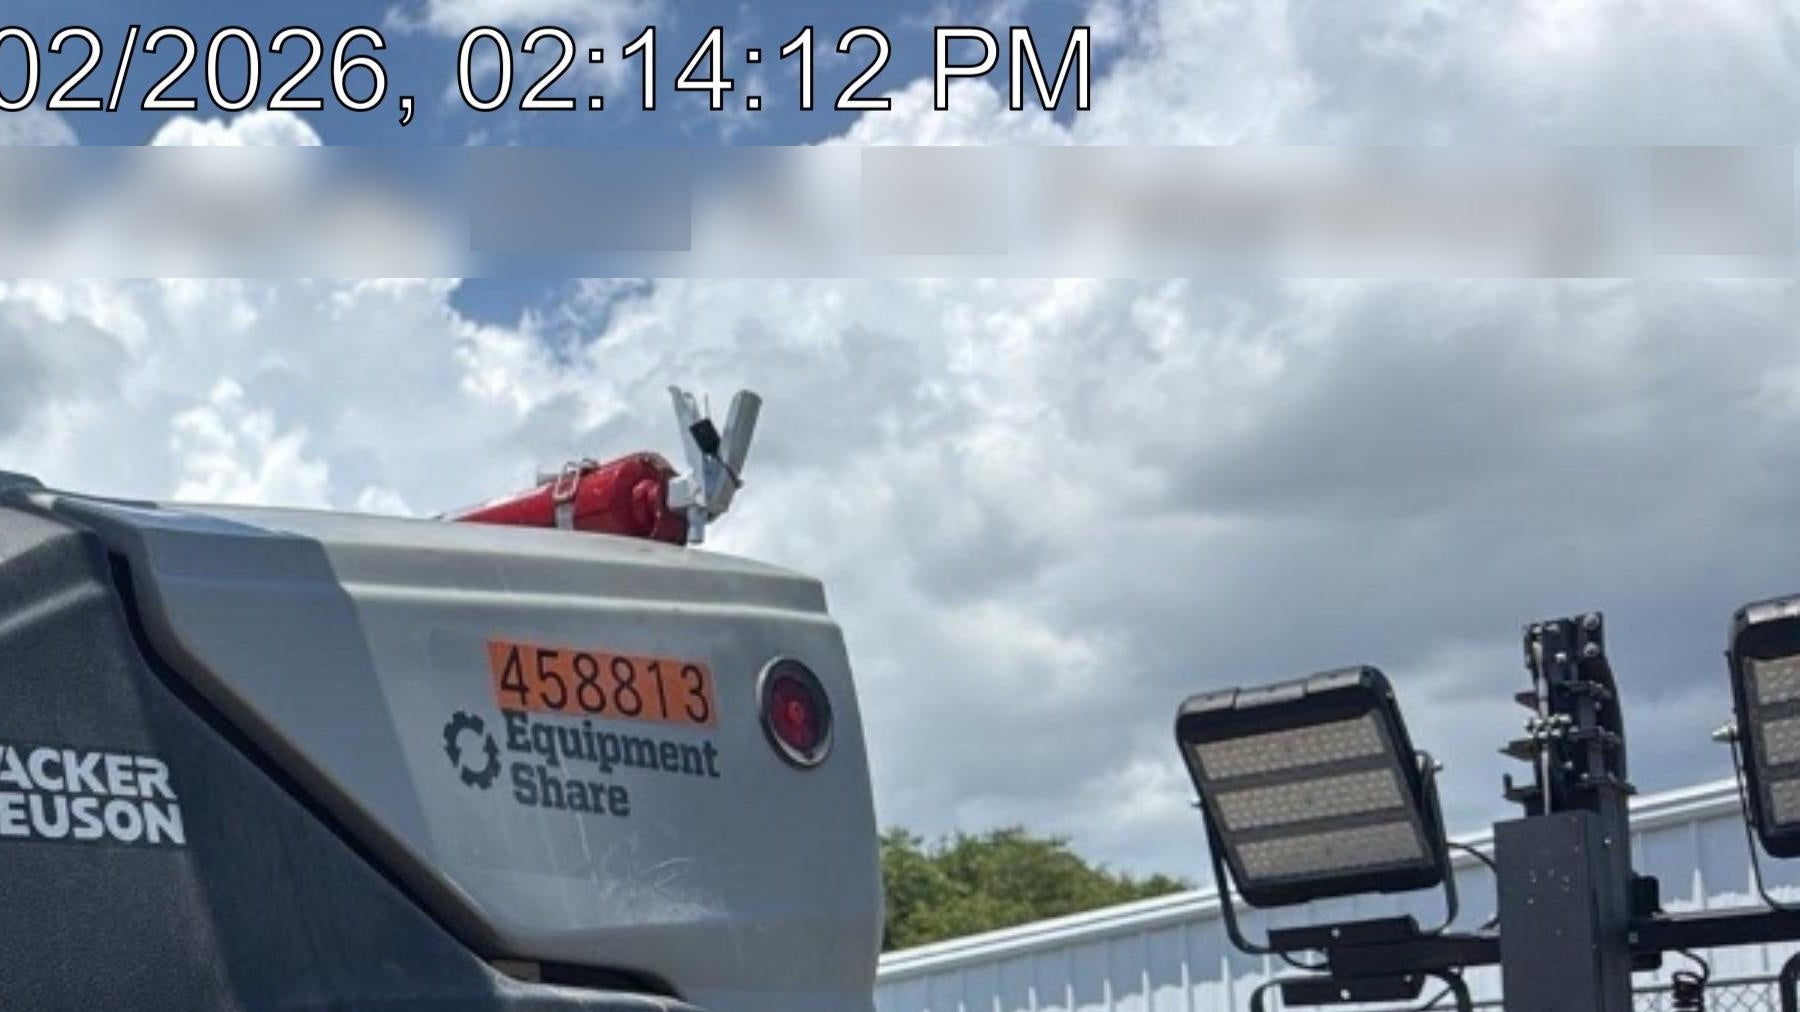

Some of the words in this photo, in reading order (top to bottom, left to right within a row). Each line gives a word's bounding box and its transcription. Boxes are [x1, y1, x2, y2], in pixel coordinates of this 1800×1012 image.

[500, 644, 710, 724] 458813
[502, 708, 721, 779] Equipment
[510, 761, 631, 818] Share
